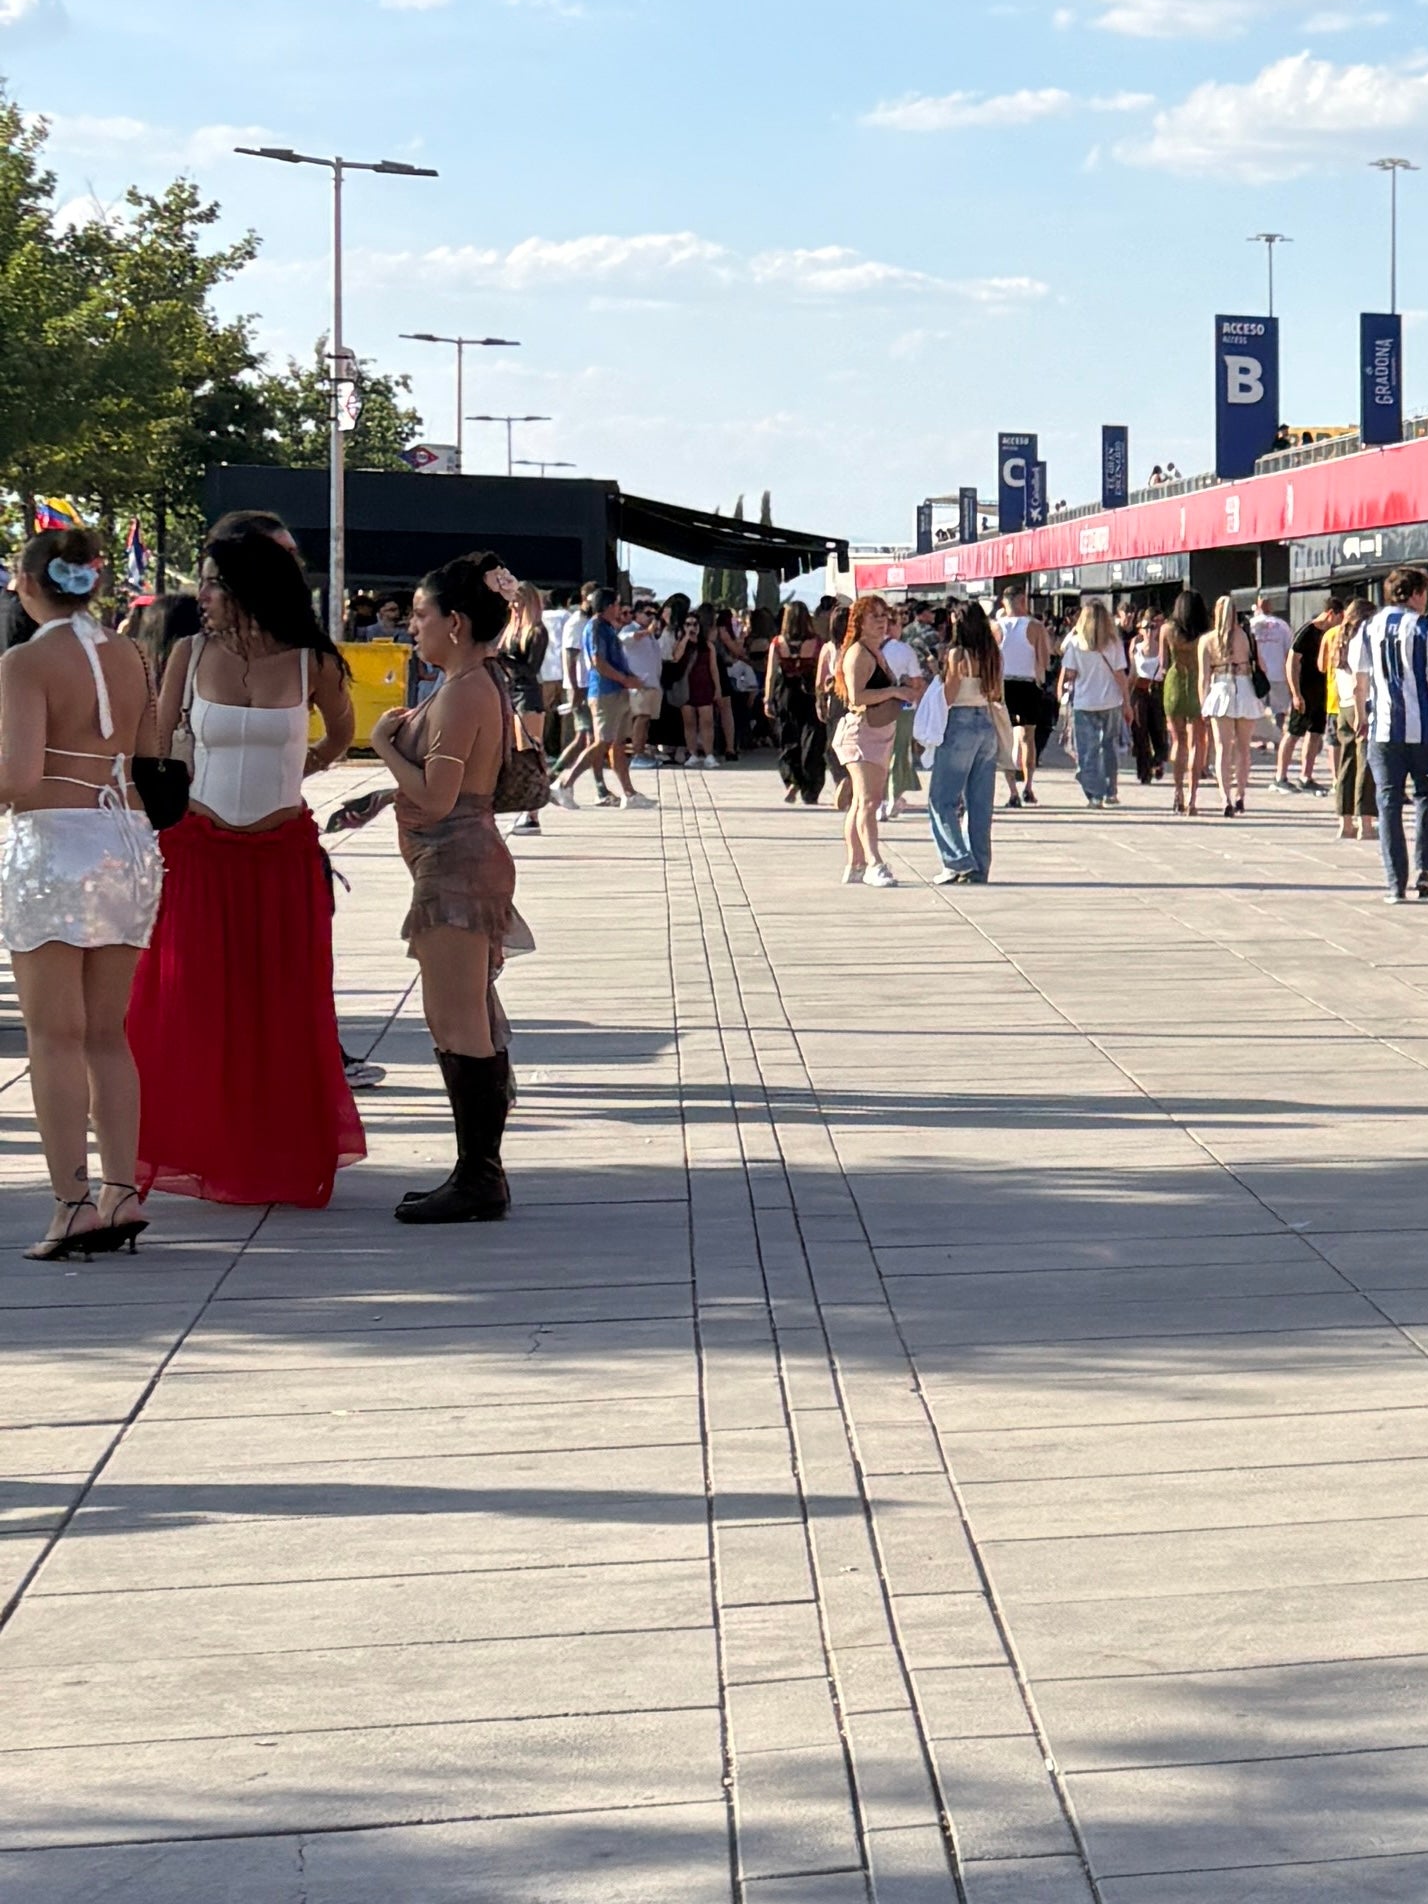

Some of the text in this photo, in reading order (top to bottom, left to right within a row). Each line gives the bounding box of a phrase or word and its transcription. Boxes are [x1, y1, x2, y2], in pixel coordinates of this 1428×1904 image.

[1222, 322, 1265, 336] ACCESO
[1222, 335, 1248, 345] ACCESS
[1223, 354, 1265, 404] B
[1002, 457, 1026, 488] C
